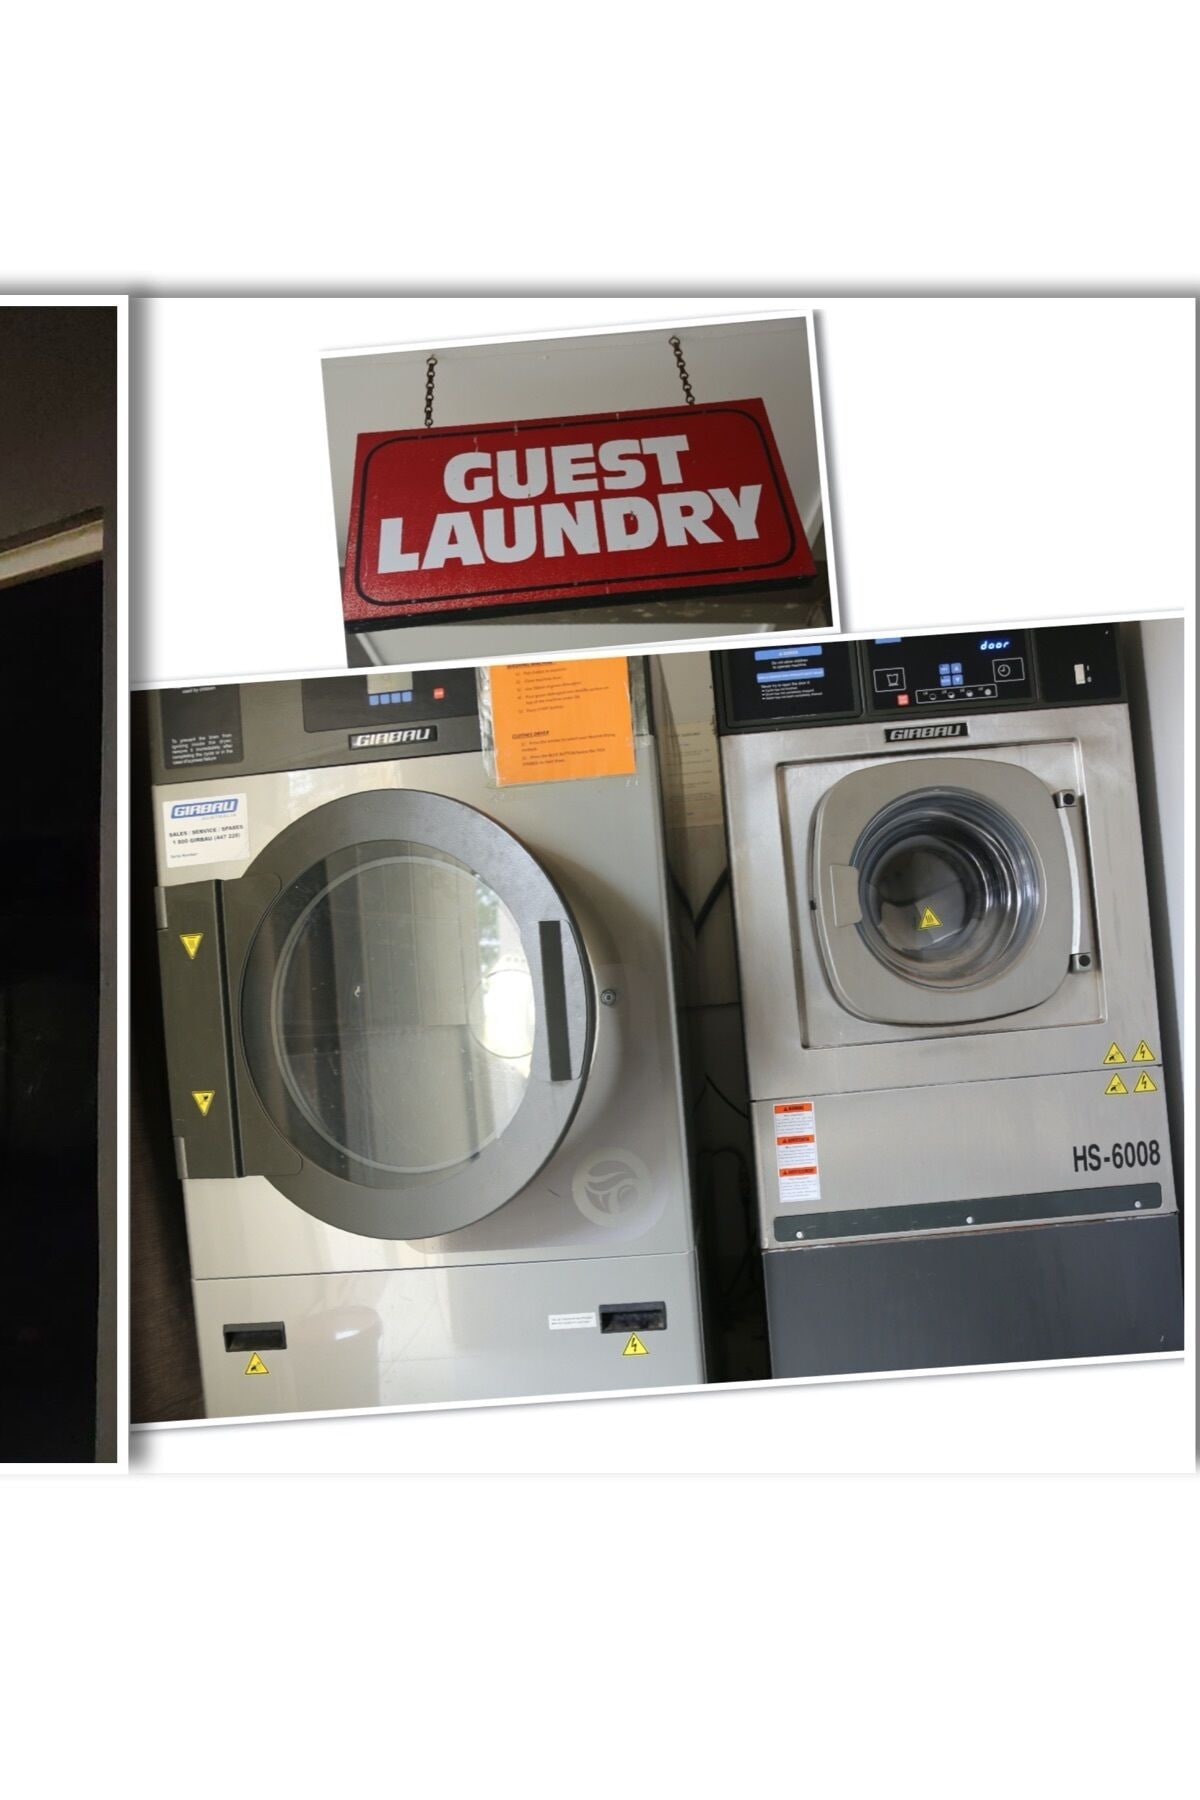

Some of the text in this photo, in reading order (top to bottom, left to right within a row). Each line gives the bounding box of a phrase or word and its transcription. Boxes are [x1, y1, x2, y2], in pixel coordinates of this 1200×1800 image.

[443, 433, 690, 504] GUEST
[377, 484, 763, 574] LAUNDRY
[980, 640, 1010, 651] door
[353, 728, 431, 747] GIRBAU
[889, 724, 963, 741] GIRBAU
[174, 801, 235, 817] GIRBAU
[1073, 1139, 1161, 1173] HS-6008
